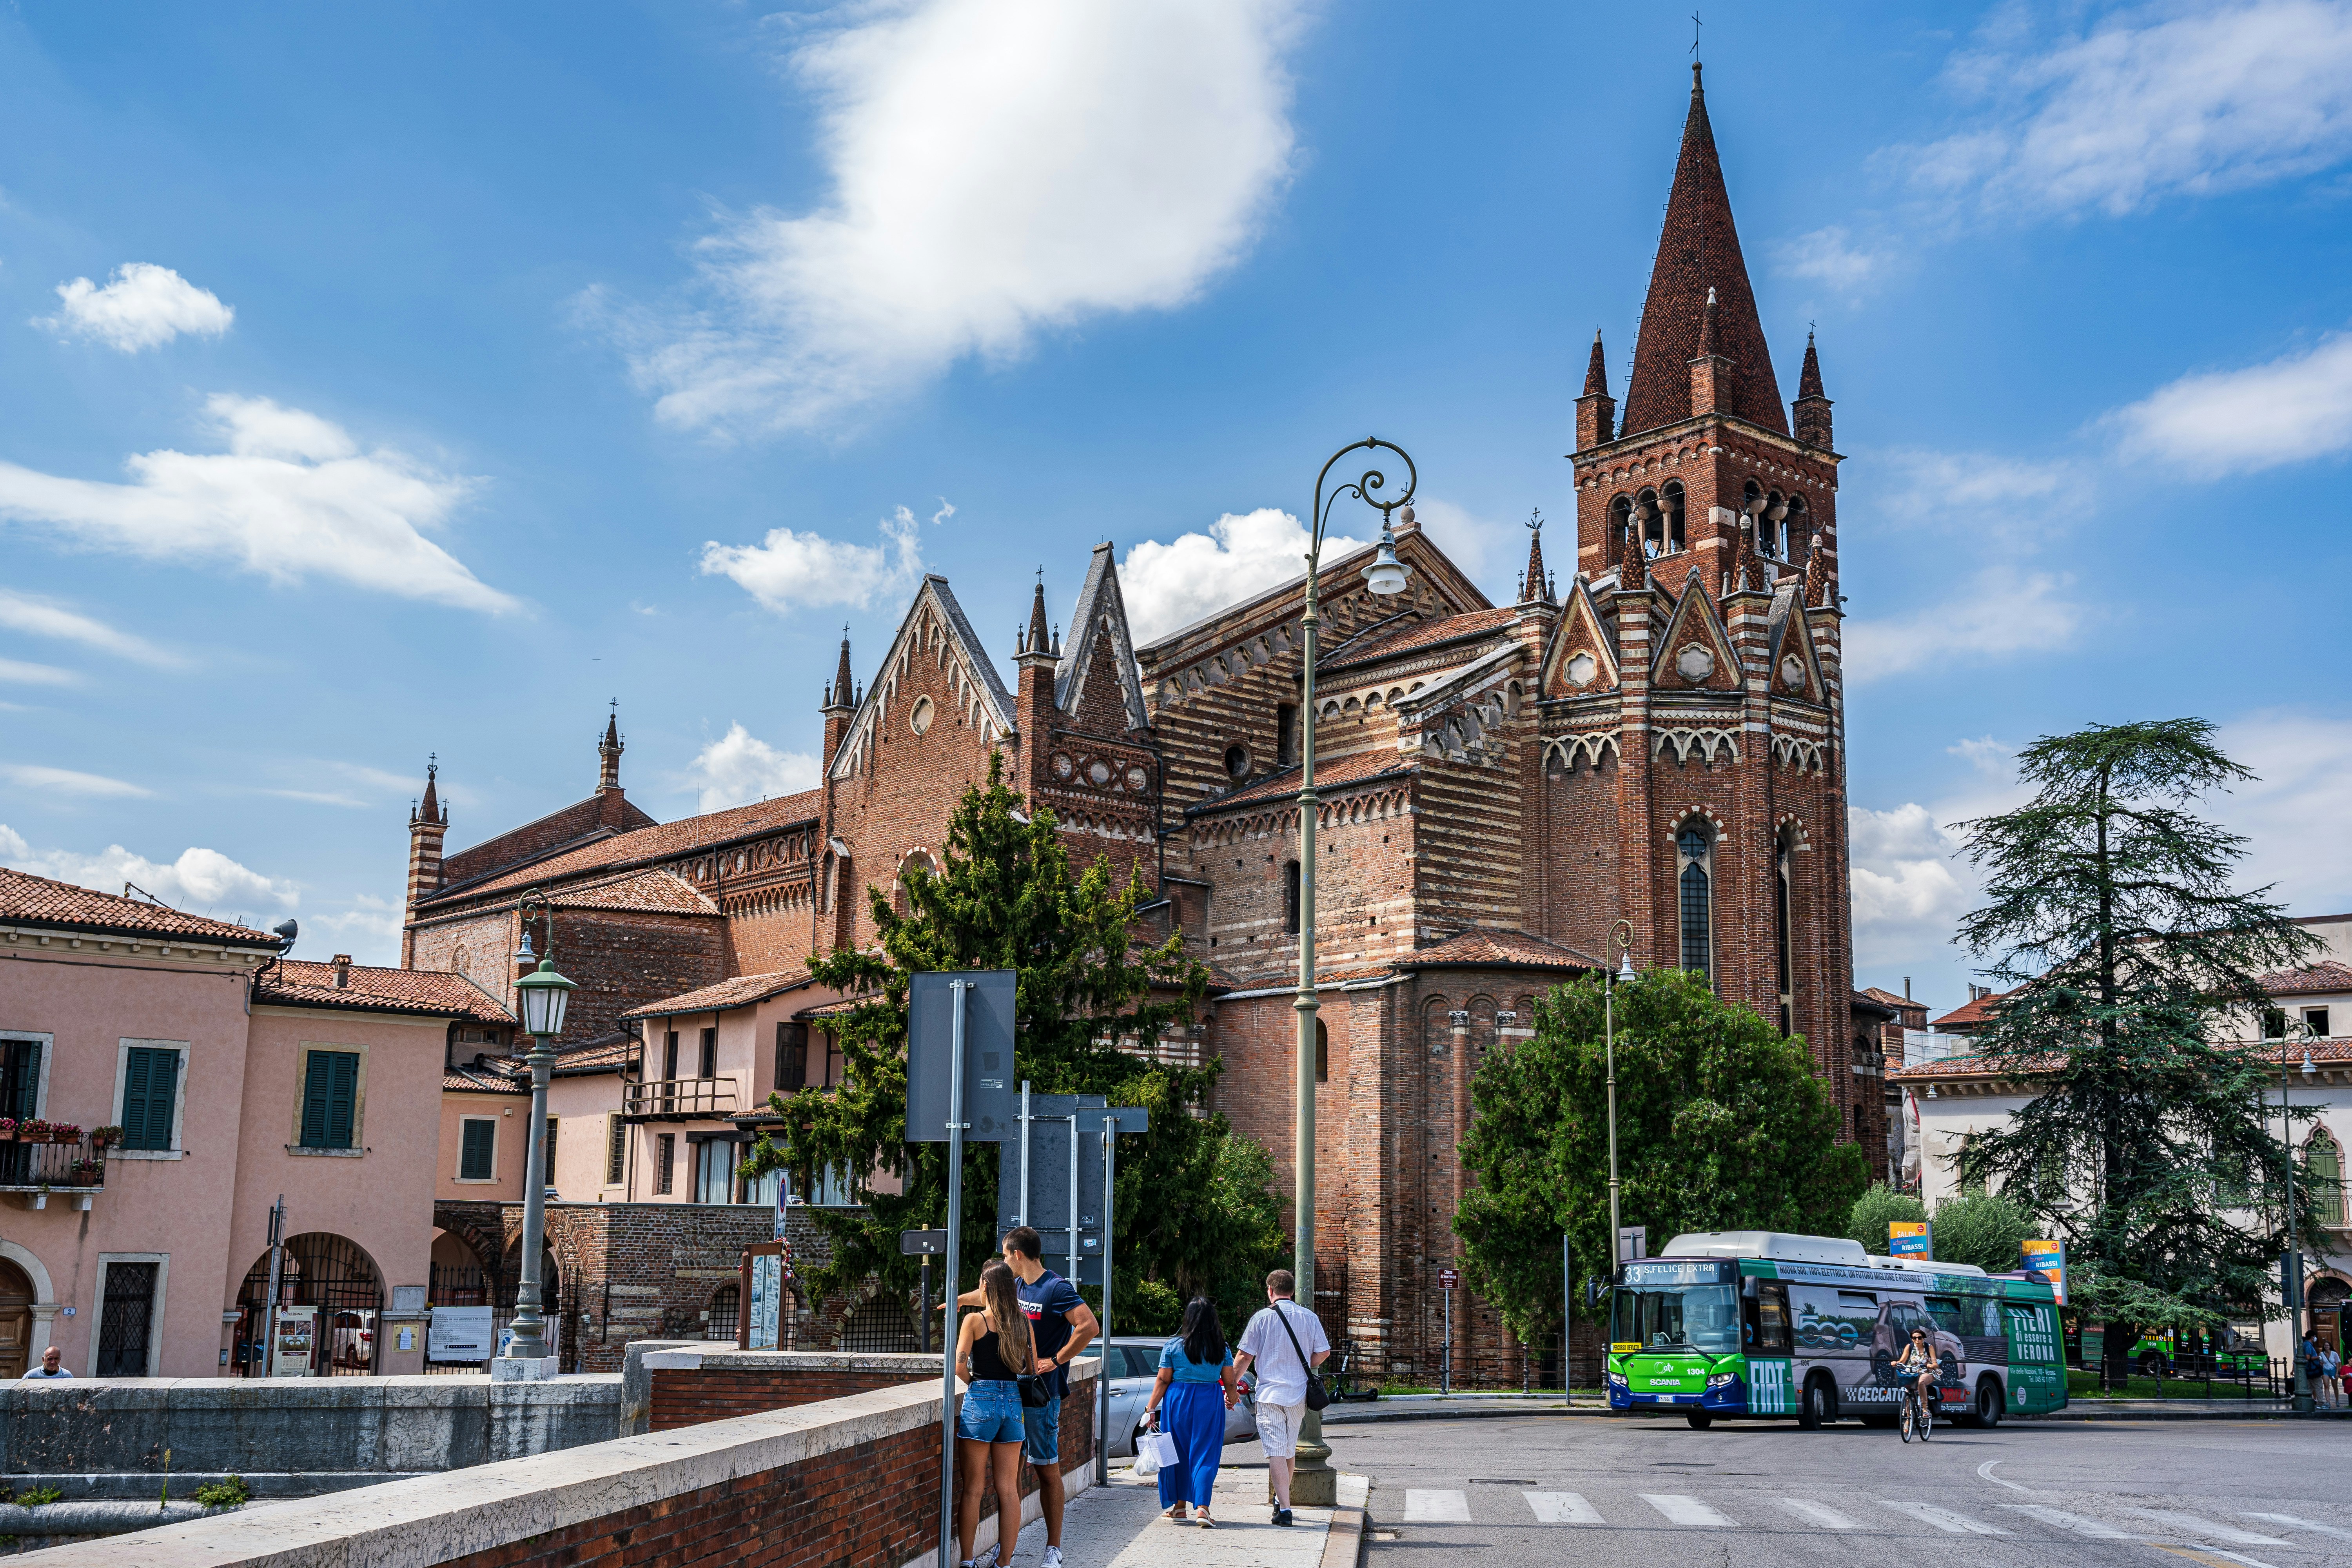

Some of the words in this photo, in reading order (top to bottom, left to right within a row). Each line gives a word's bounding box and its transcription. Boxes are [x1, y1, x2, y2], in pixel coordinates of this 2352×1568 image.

[1625, 1266, 1641, 1282] 33
[1644, 1265, 1683, 1273] S.FELICE
[1686, 1264, 1715, 1272] EXTRA
[1779, 1265, 1797, 1274] NUOVA
[1797, 1267, 1808, 1275] 500.
[1808, 1267, 1821, 1276] 100%
[1821, 1268, 1848, 1278] ELETTRICA.
[1848, 1270, 1855, 1278] UN
[1855, 1270, 1873, 1279] FUTURO
[1874, 1272, 1895, 1281] MIGLIORE
[1894, 1272, 1899, 1281] È
[2007, 1307, 2051, 1333] FIERI
[2016, 1330, 2022, 1342] di
[2024, 1333, 2047, 1343] essere
[2048, 1335, 2053, 1343] a
[2016, 1344, 2054, 1361] VERONA
[1663, 1363, 1674, 1372] atv
[1749, 1361, 1786, 1413] FIAT
[1858, 1387, 1903, 1402] CECCATO
